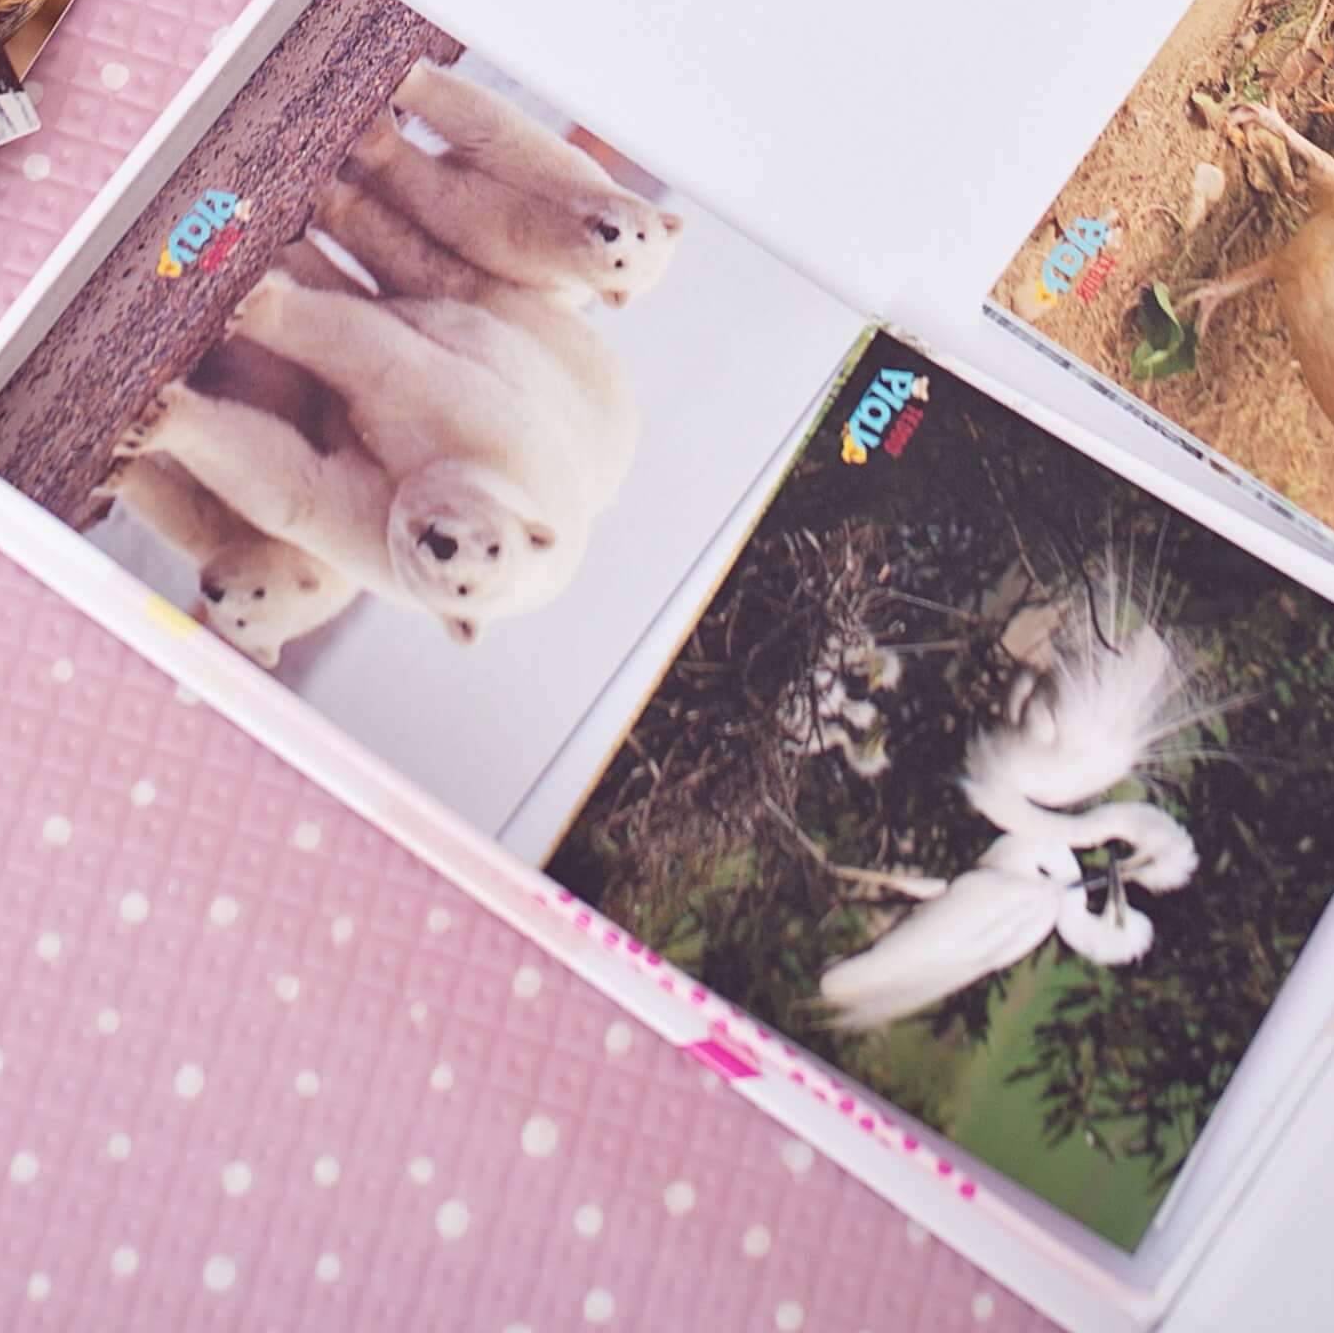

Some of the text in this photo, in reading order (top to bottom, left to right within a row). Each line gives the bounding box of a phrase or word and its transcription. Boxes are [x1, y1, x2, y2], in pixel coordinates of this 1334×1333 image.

[169, 189, 238, 264] Play
[1042, 217, 1109, 293] Play
[849, 368, 914, 449] Play
